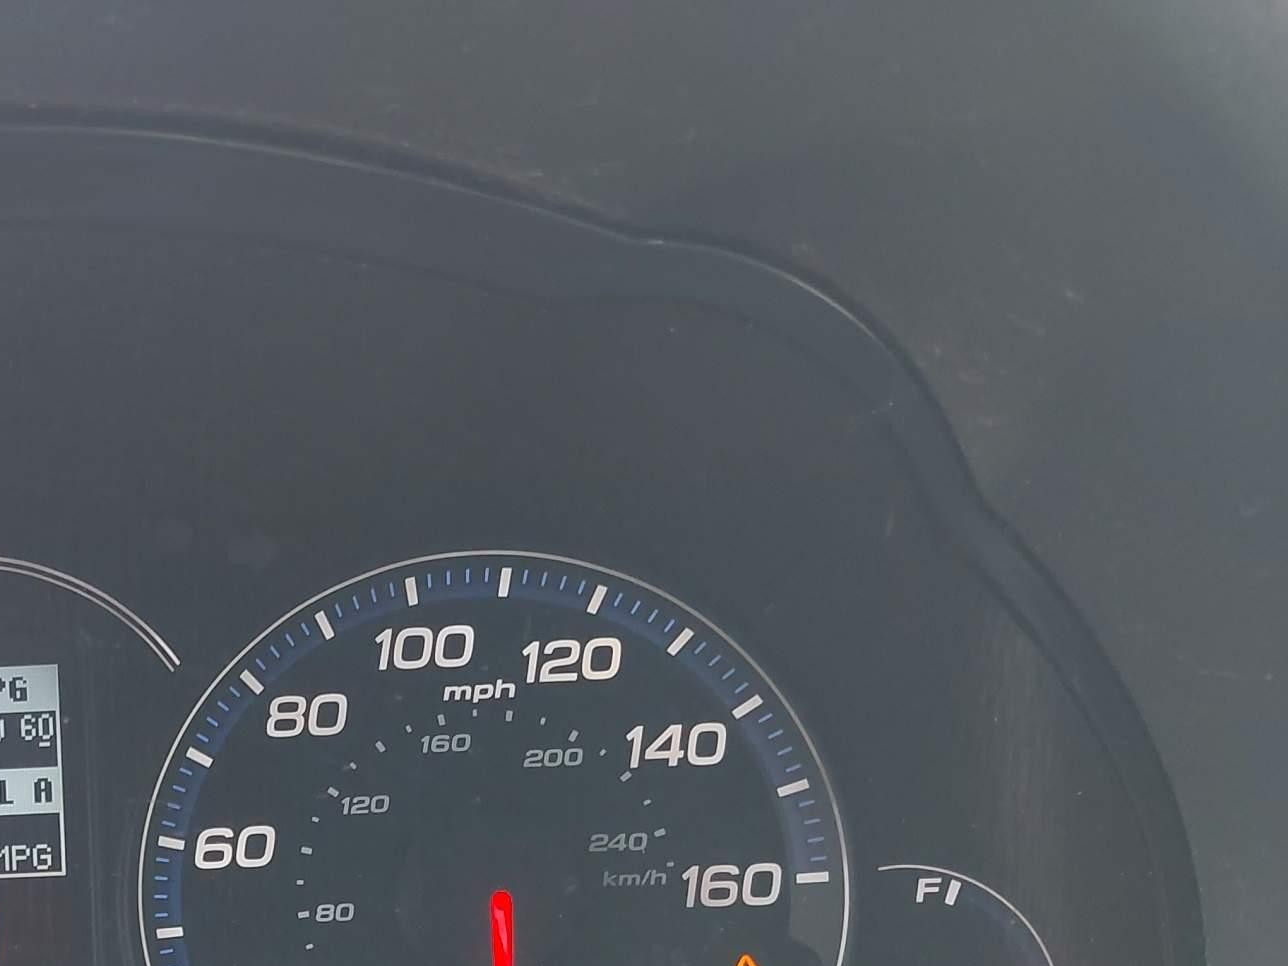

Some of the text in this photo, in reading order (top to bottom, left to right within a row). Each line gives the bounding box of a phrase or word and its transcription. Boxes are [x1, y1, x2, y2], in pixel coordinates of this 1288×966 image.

[374, 624, 475, 670] 100
[521, 637, 622, 684] 120
[443, 678, 516, 703] mph
[20, 713, 54, 740] 60
[265, 693, 348, 737] 80
[420, 733, 471, 753] 160
[624, 722, 727, 768] 140
[523, 747, 583, 768] 200
[34, 778, 53, 803] A
[341, 794, 390, 815] 120
[193, 825, 276, 869] 60
[589, 832, 648, 852] 240
[602, 867, 667, 887] km/h
[681, 863, 782, 908] 160
[916, 878, 942, 903] F
[316, 902, 354, 922] 80
